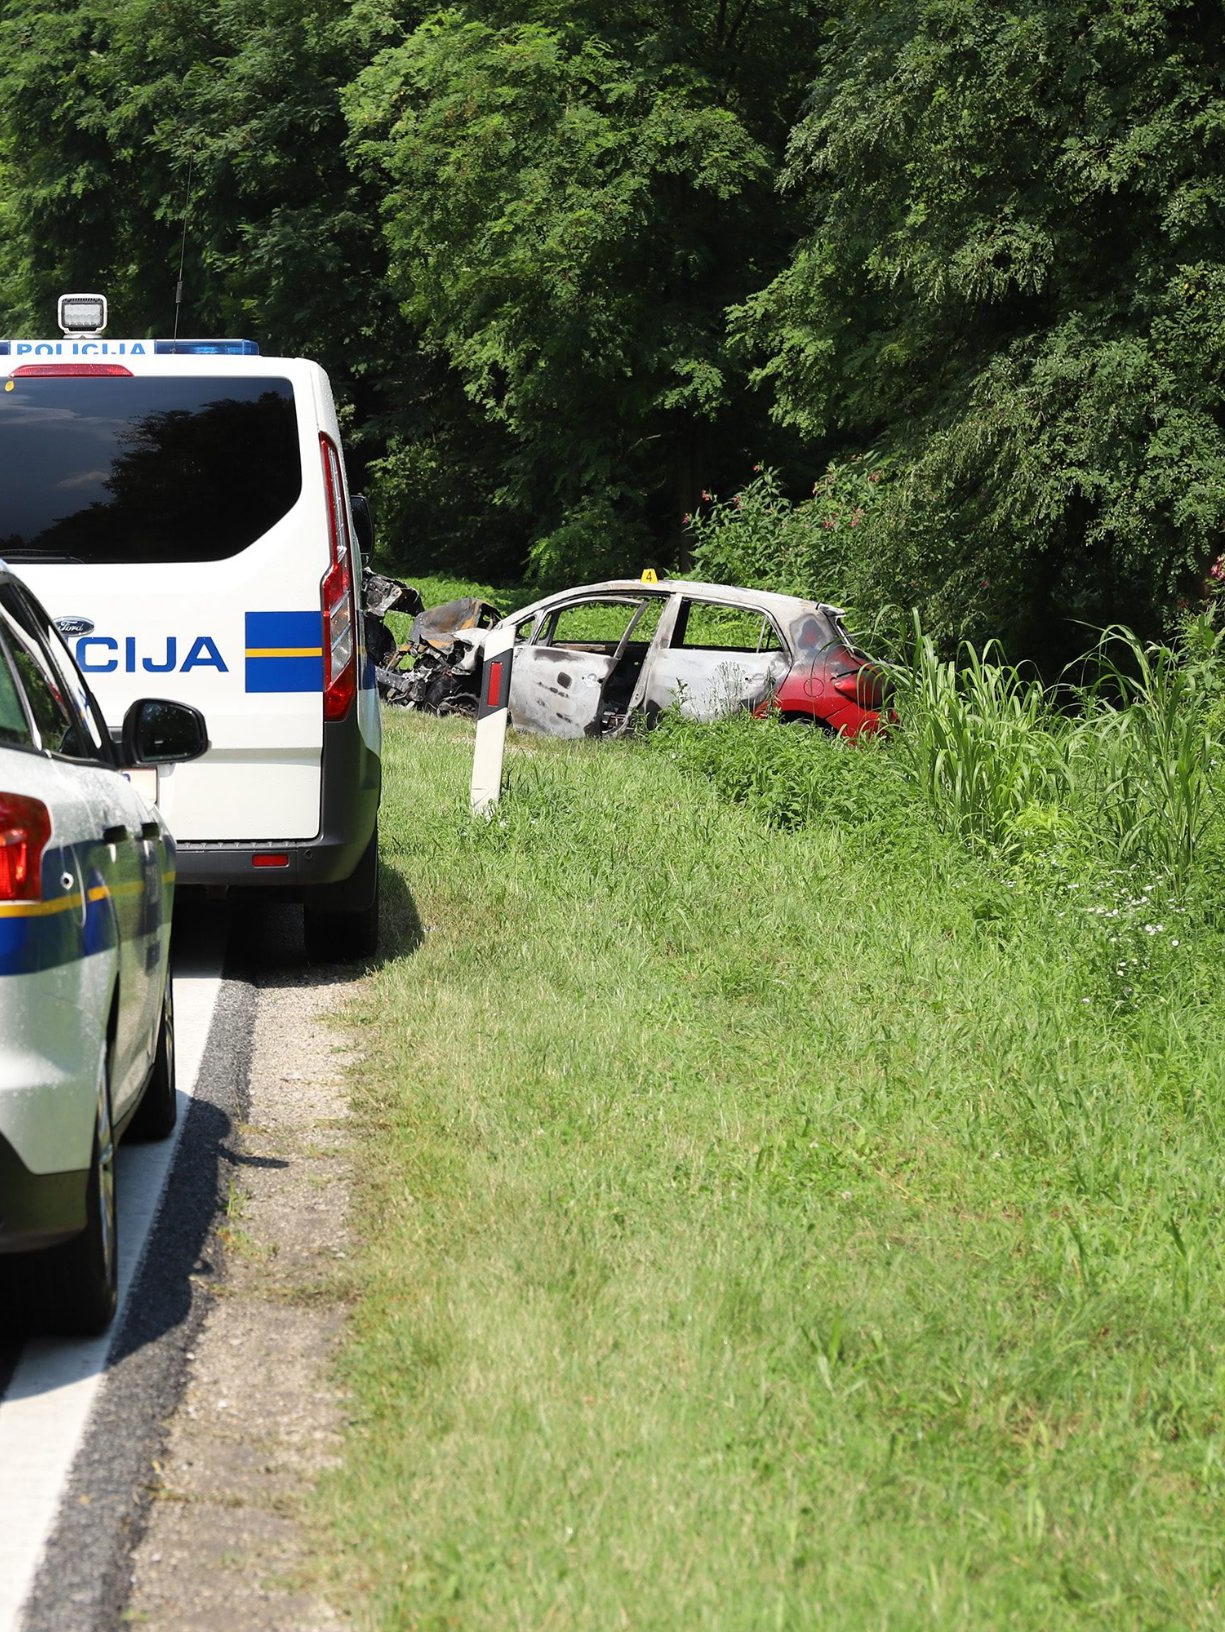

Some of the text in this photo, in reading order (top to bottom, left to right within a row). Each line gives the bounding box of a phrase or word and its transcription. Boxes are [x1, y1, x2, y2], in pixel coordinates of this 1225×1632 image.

[16, 343, 146, 355] POLICIJA
[58, 620, 84, 632] Ford
[63, 636, 230, 673] CIJA
